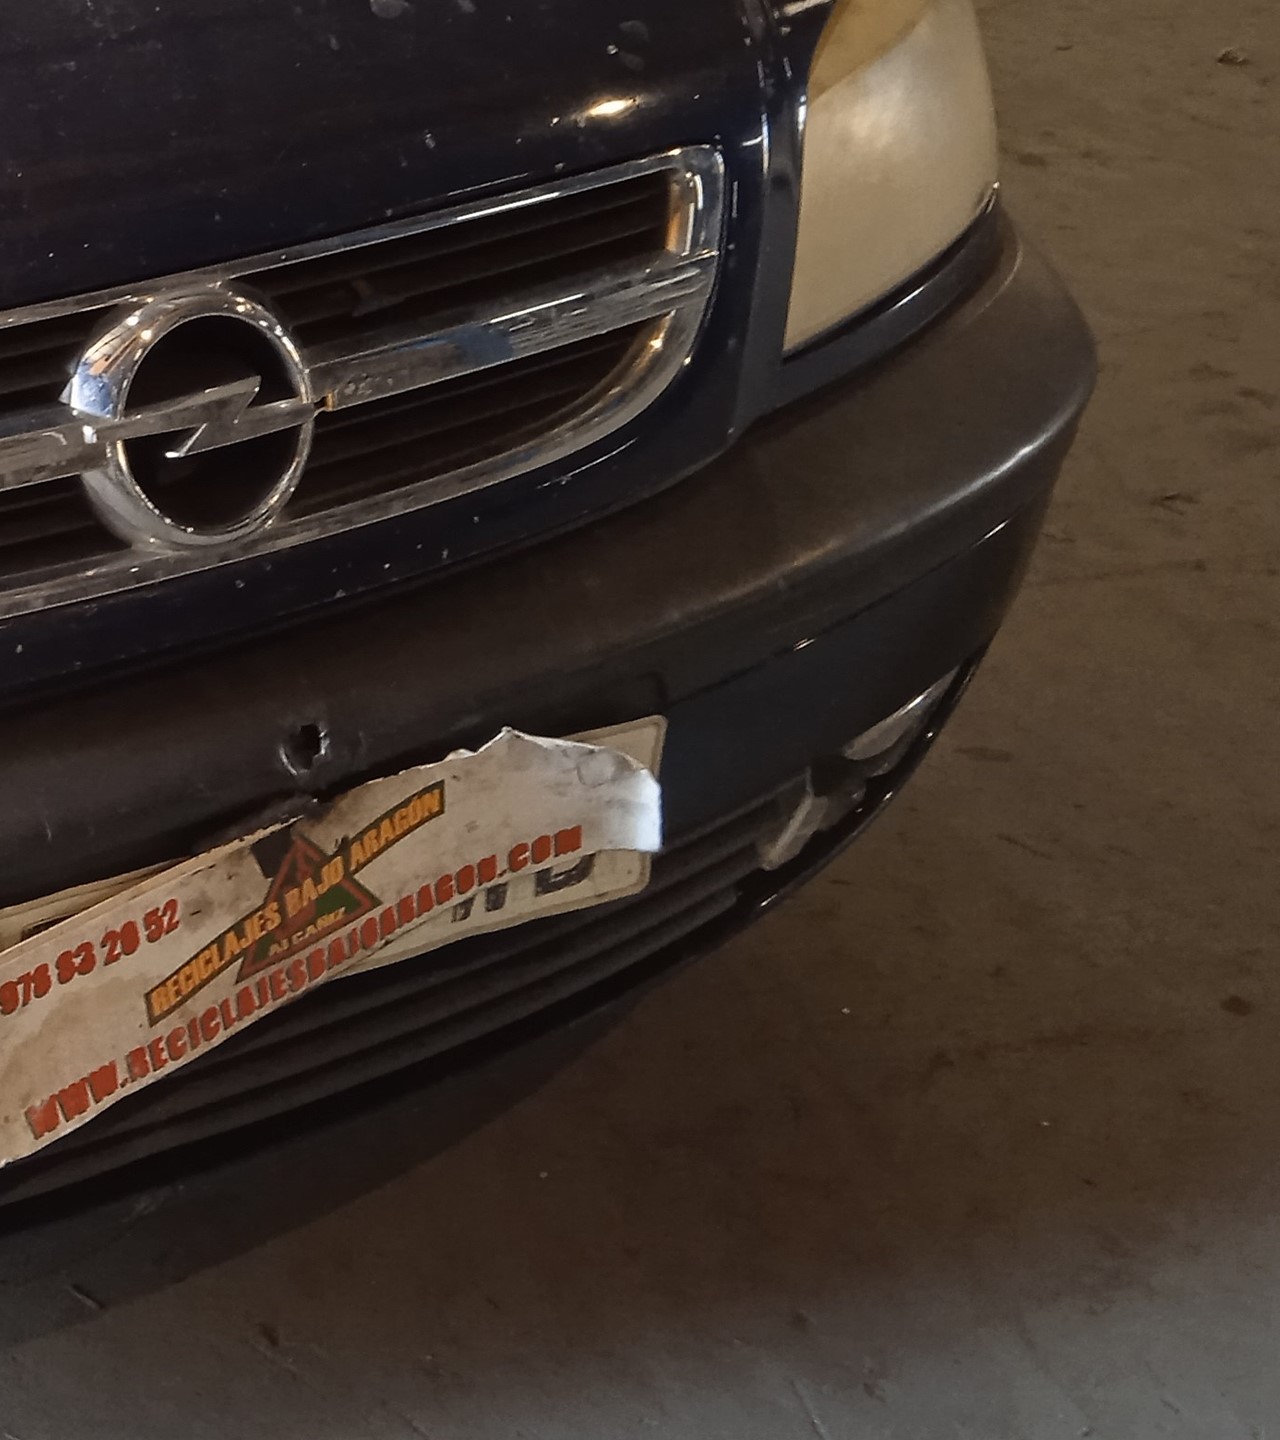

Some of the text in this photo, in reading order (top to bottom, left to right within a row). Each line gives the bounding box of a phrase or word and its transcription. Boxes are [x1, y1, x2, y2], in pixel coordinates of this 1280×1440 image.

[55, 941, 97, 985] 83
[144, 898, 181, 943] 52
[149, 788, 441, 1017] RECICLAJES BAJO ARAGÓN
